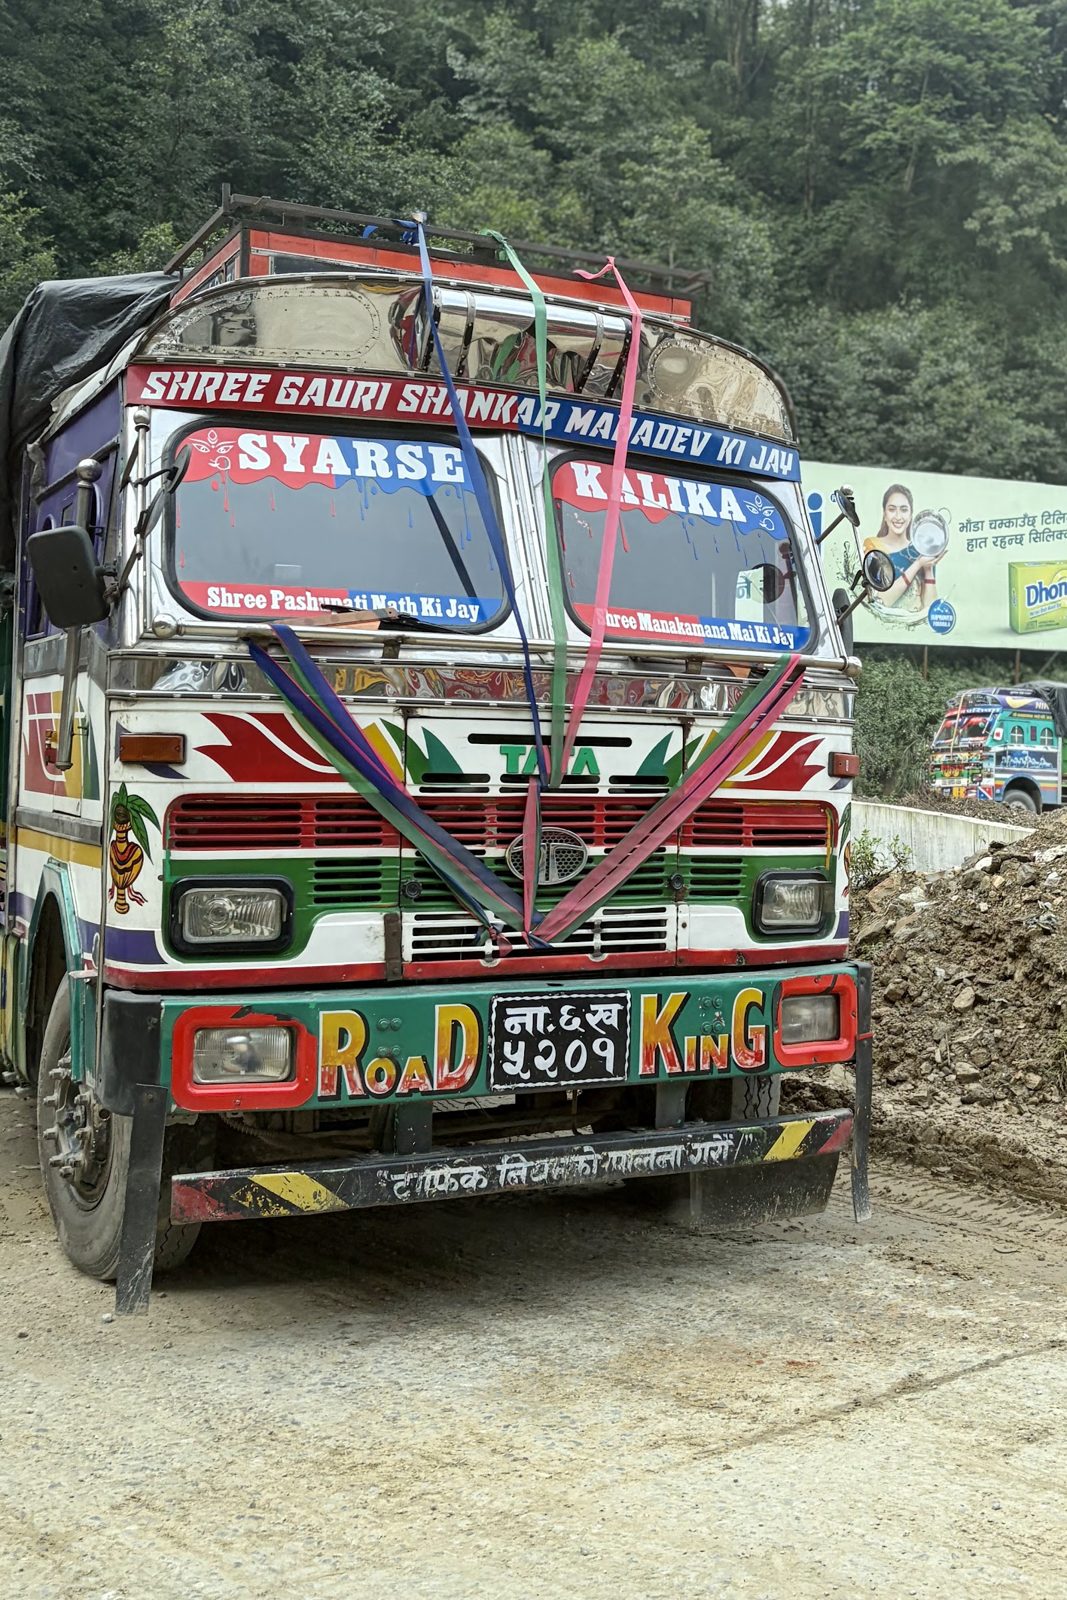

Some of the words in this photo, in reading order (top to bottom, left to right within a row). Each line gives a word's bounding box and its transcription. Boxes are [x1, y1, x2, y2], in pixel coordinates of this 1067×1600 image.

[141, 371, 272, 403] SHREE
[275, 376, 393, 412] GAURI
[396, 383, 561, 431] SHANKAR
[716, 435, 747, 465] KI
[749, 445, 794, 476] JAY
[236, 433, 465, 483] SYARSE
[569, 461, 747, 523] KALIKA
[1041, 509, 1067, 526] टिलि
[966, 536, 988, 552] हात
[207, 586, 268, 609] Shree
[370, 594, 418, 616] Nath
[420, 597, 442, 617] Ki
[445, 598, 480, 623] Jay
[636, 612, 729, 640] Manakamana
[727, 622, 755, 642] Mai
[754, 625, 772, 644] Ki
[772, 627, 794, 650] Jay
[502, 1037, 615, 1080] ५२०१
